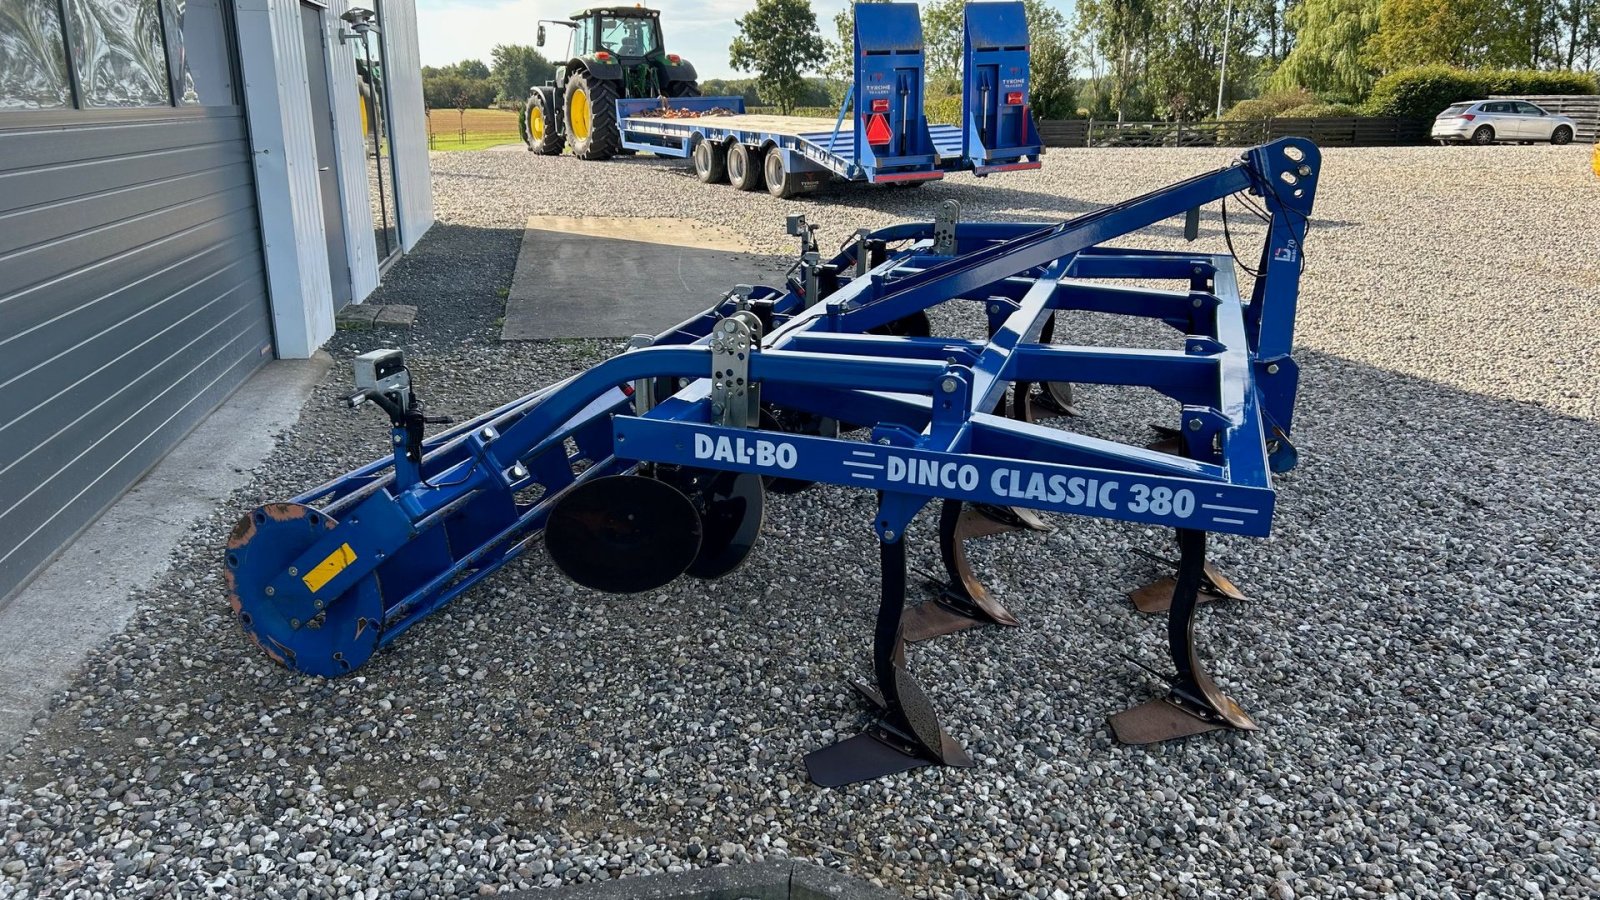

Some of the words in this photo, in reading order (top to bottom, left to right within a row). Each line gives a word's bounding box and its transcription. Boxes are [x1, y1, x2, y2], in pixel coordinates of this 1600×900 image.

[886, 456, 979, 491] DINCO
[990, 468, 1119, 511] CLASSIC
[1127, 483, 1196, 519] 380
